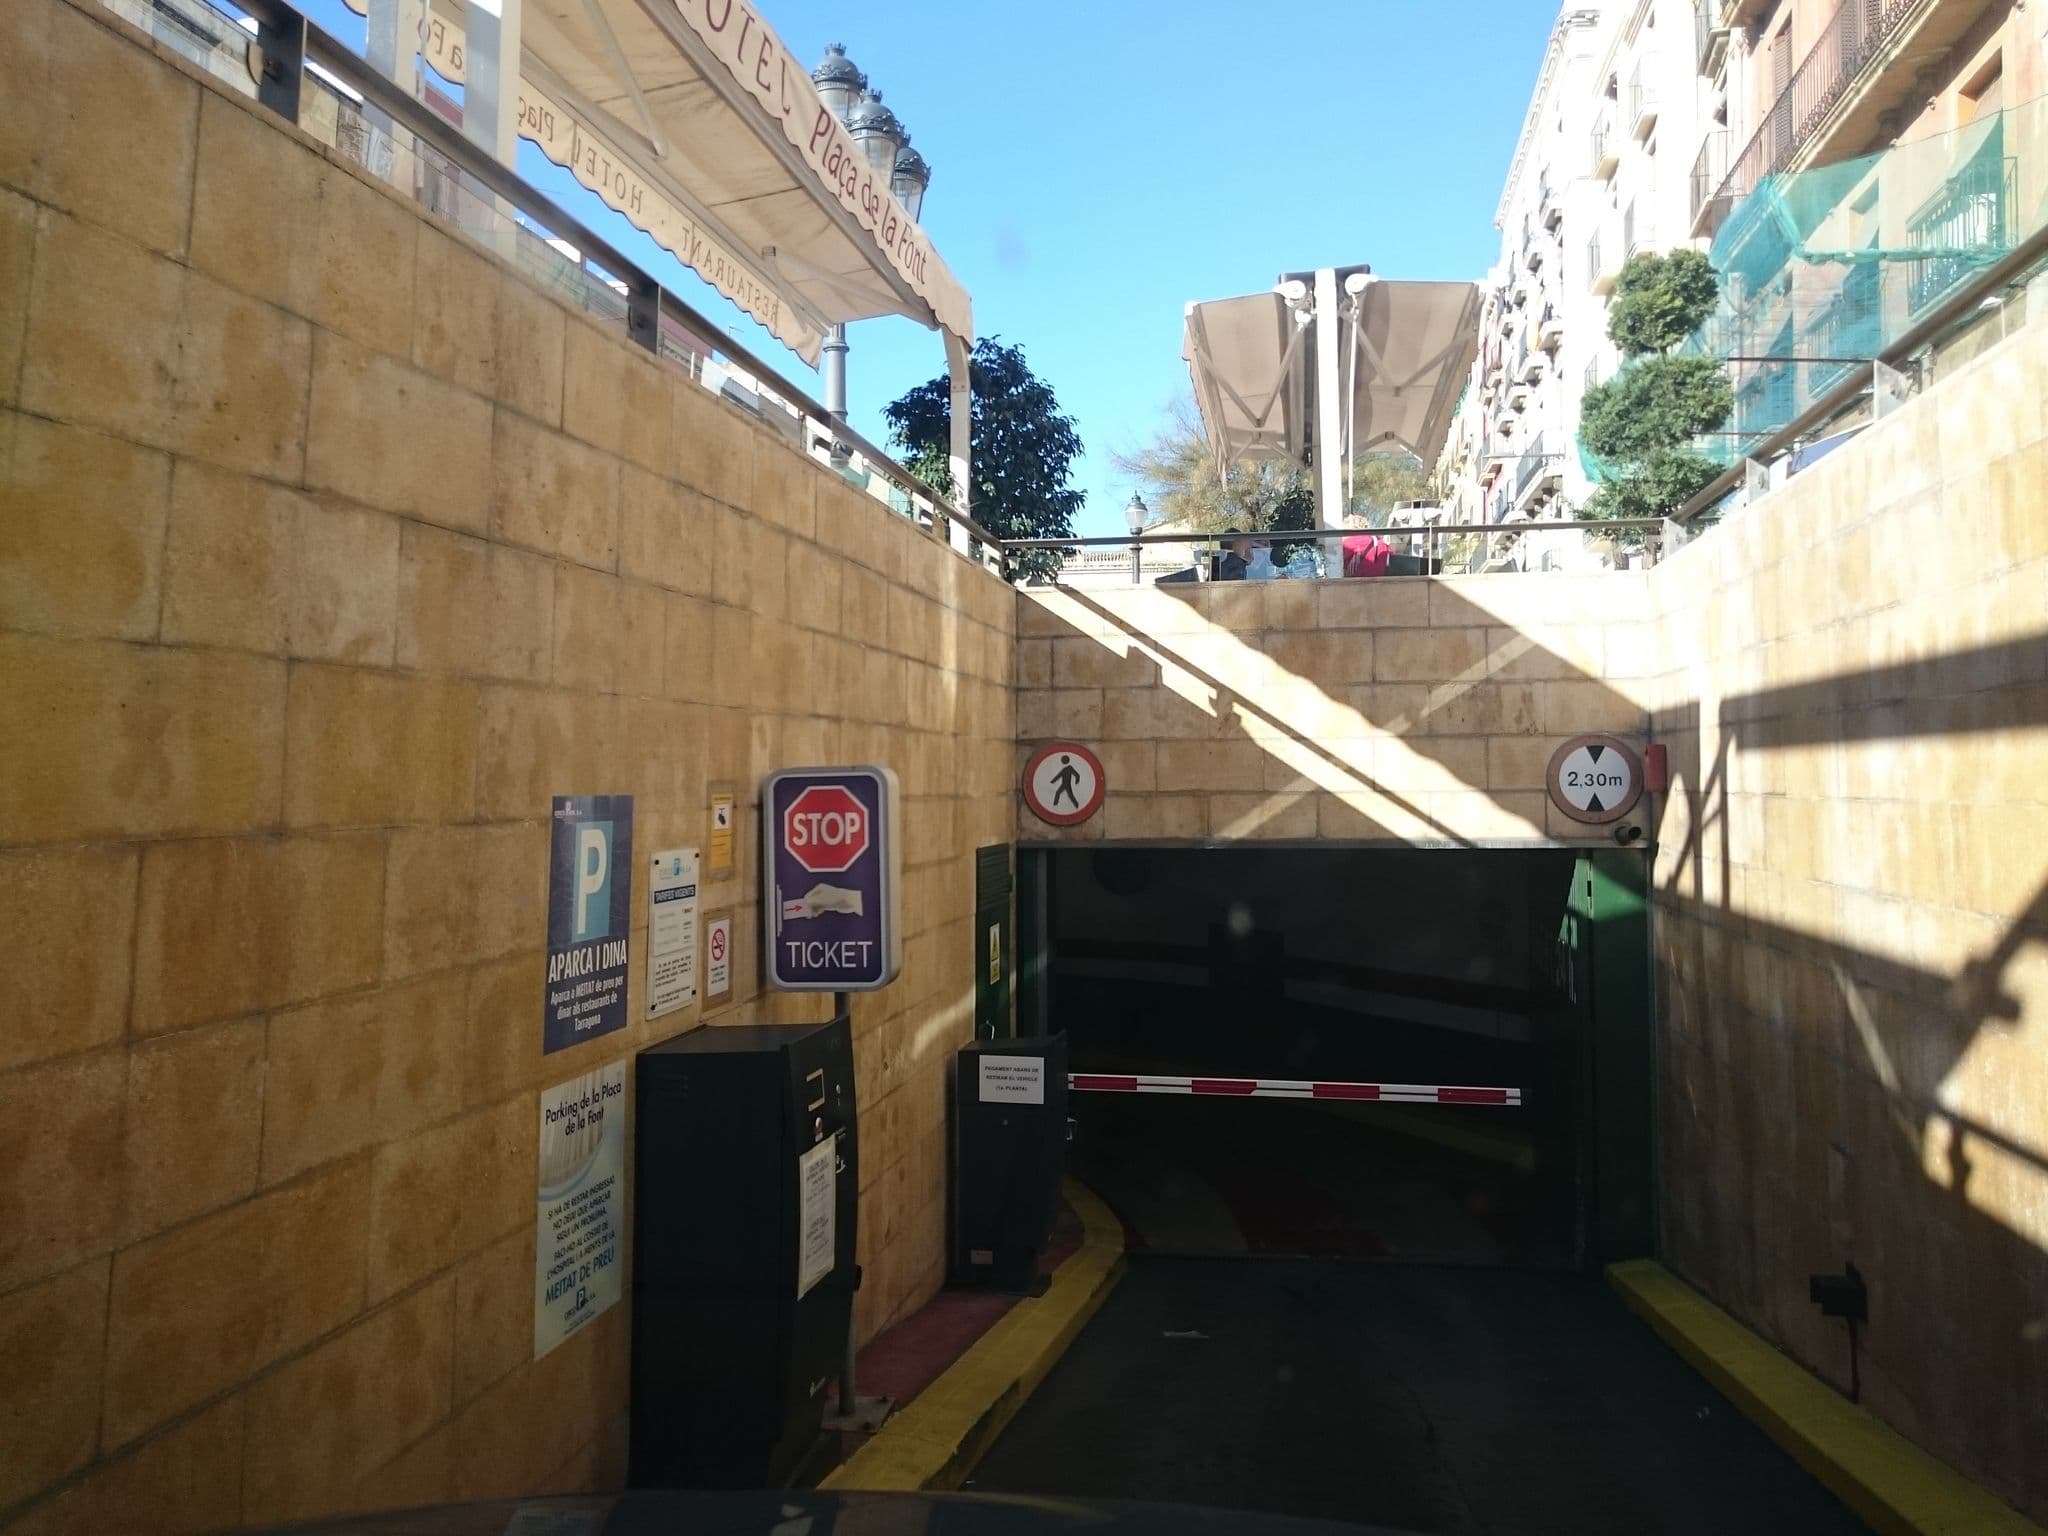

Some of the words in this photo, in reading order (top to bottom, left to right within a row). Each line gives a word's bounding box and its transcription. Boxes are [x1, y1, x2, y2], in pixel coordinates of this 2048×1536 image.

[809, 104, 858, 200] Plaça
[861, 175, 880, 225] de
[880, 198, 897, 248] la
[897, 222, 928, 285] Font
[792, 812, 861, 846] STOP
[577, 829, 607, 934] P
[548, 947, 593, 983] APARCA
[596, 945, 600, 971] I
[602, 939, 627, 970] DINA
[786, 941, 873, 968] TICKET
[551, 990, 570, 1006] Aparca
[575, 980, 595, 998] MEITAT
[595, 978, 602, 992] de
[603, 978, 615, 992] preu
[615, 976, 624, 988] per
[557, 1005, 572, 1020] dinar
[572, 1001, 580, 1015] als
[581, 994, 610, 1012] restaurants
[610, 991, 618, 1004] de
[575, 1014, 601, 1031] Tarragona
[545, 1101, 578, 1125] Parking
[580, 1091, 590, 1109] de
[592, 1088, 600, 1105] la
[565, 1117, 576, 1136] de
[577, 1113, 586, 1130] la
[588, 1106, 604, 1126] Font
[545, 1270, 577, 1305] MEITAT
[579, 1260, 590, 1282] DE
[593, 1246, 614, 1272] PREU
